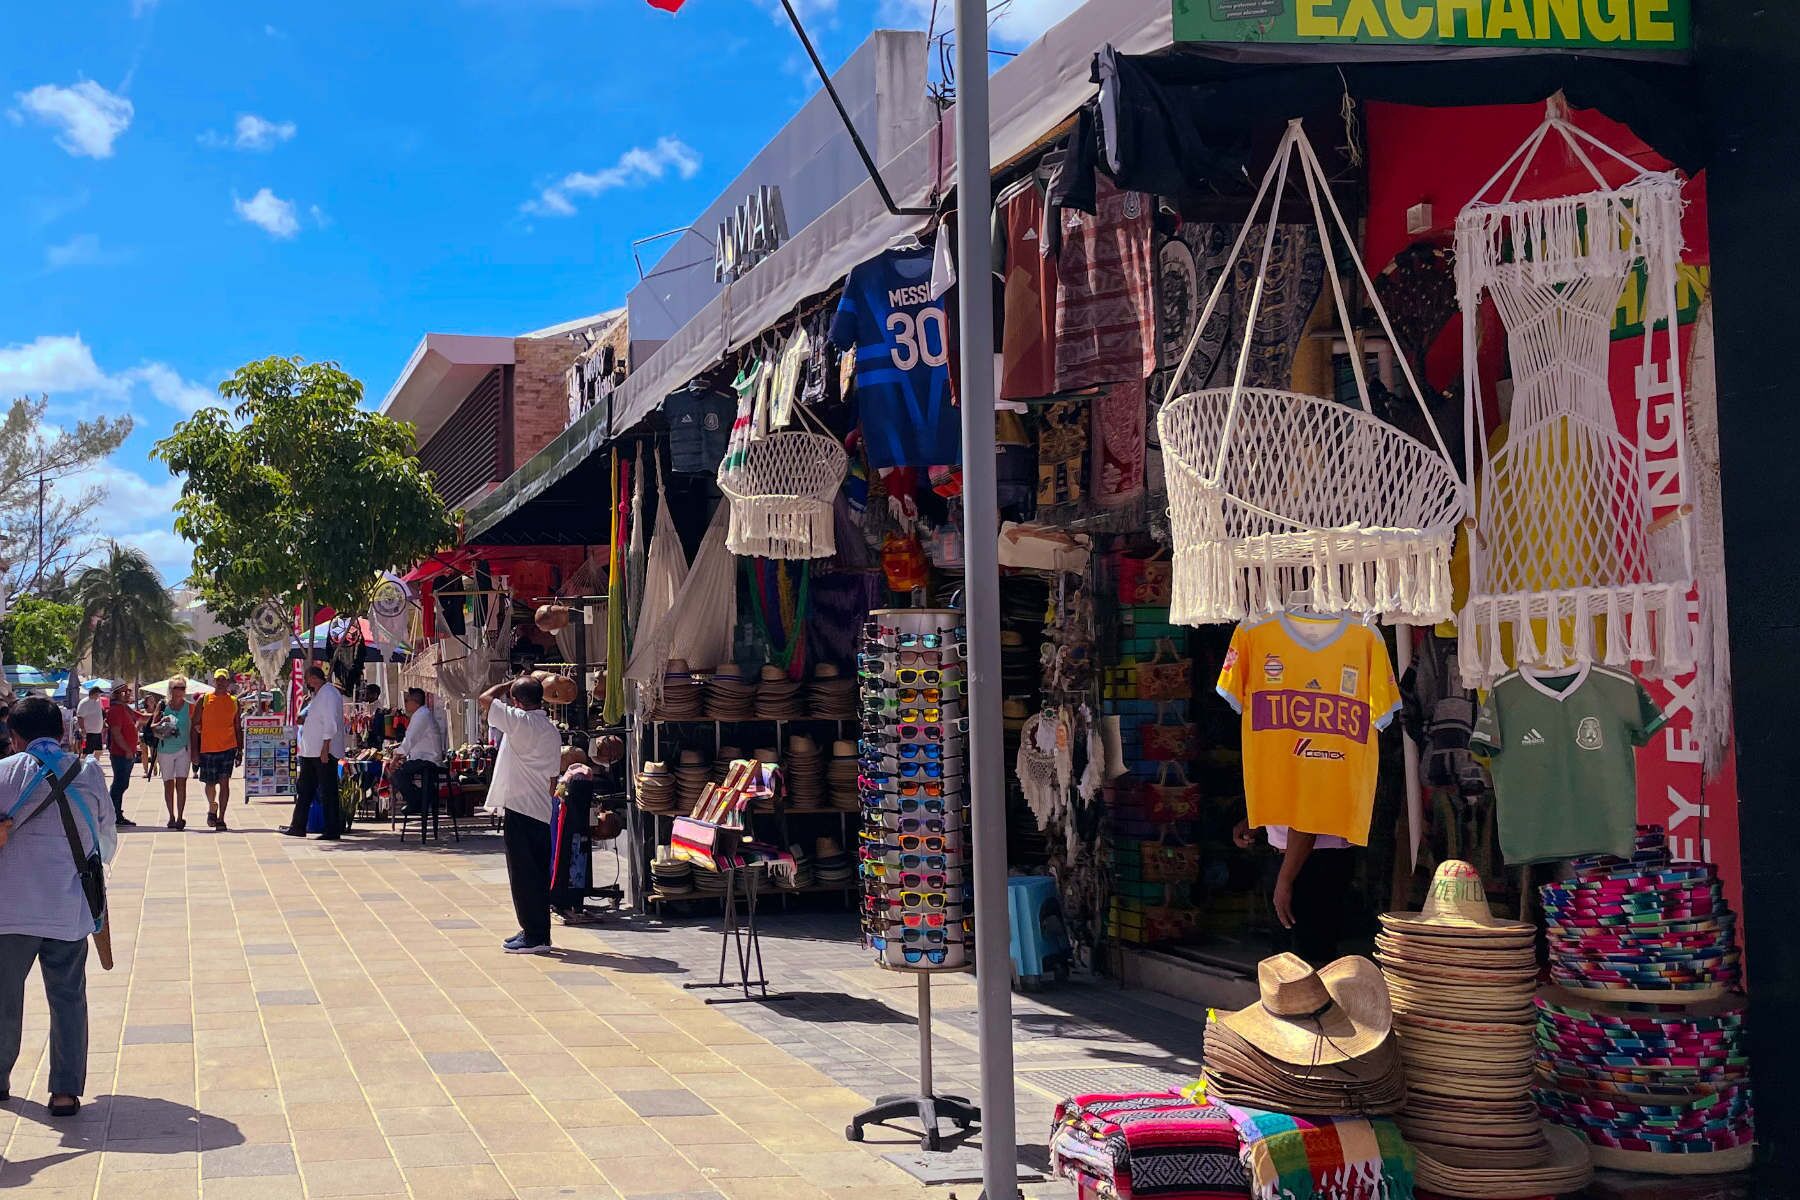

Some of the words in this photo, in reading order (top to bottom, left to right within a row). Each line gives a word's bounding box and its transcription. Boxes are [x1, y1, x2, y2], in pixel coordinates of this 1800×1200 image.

[1296, 0, 1675, 42] EXCHANGE
[888, 281, 932, 308] MESSI
[886, 307, 948, 371] 30
[1266, 694, 1362, 737] TIGRES
